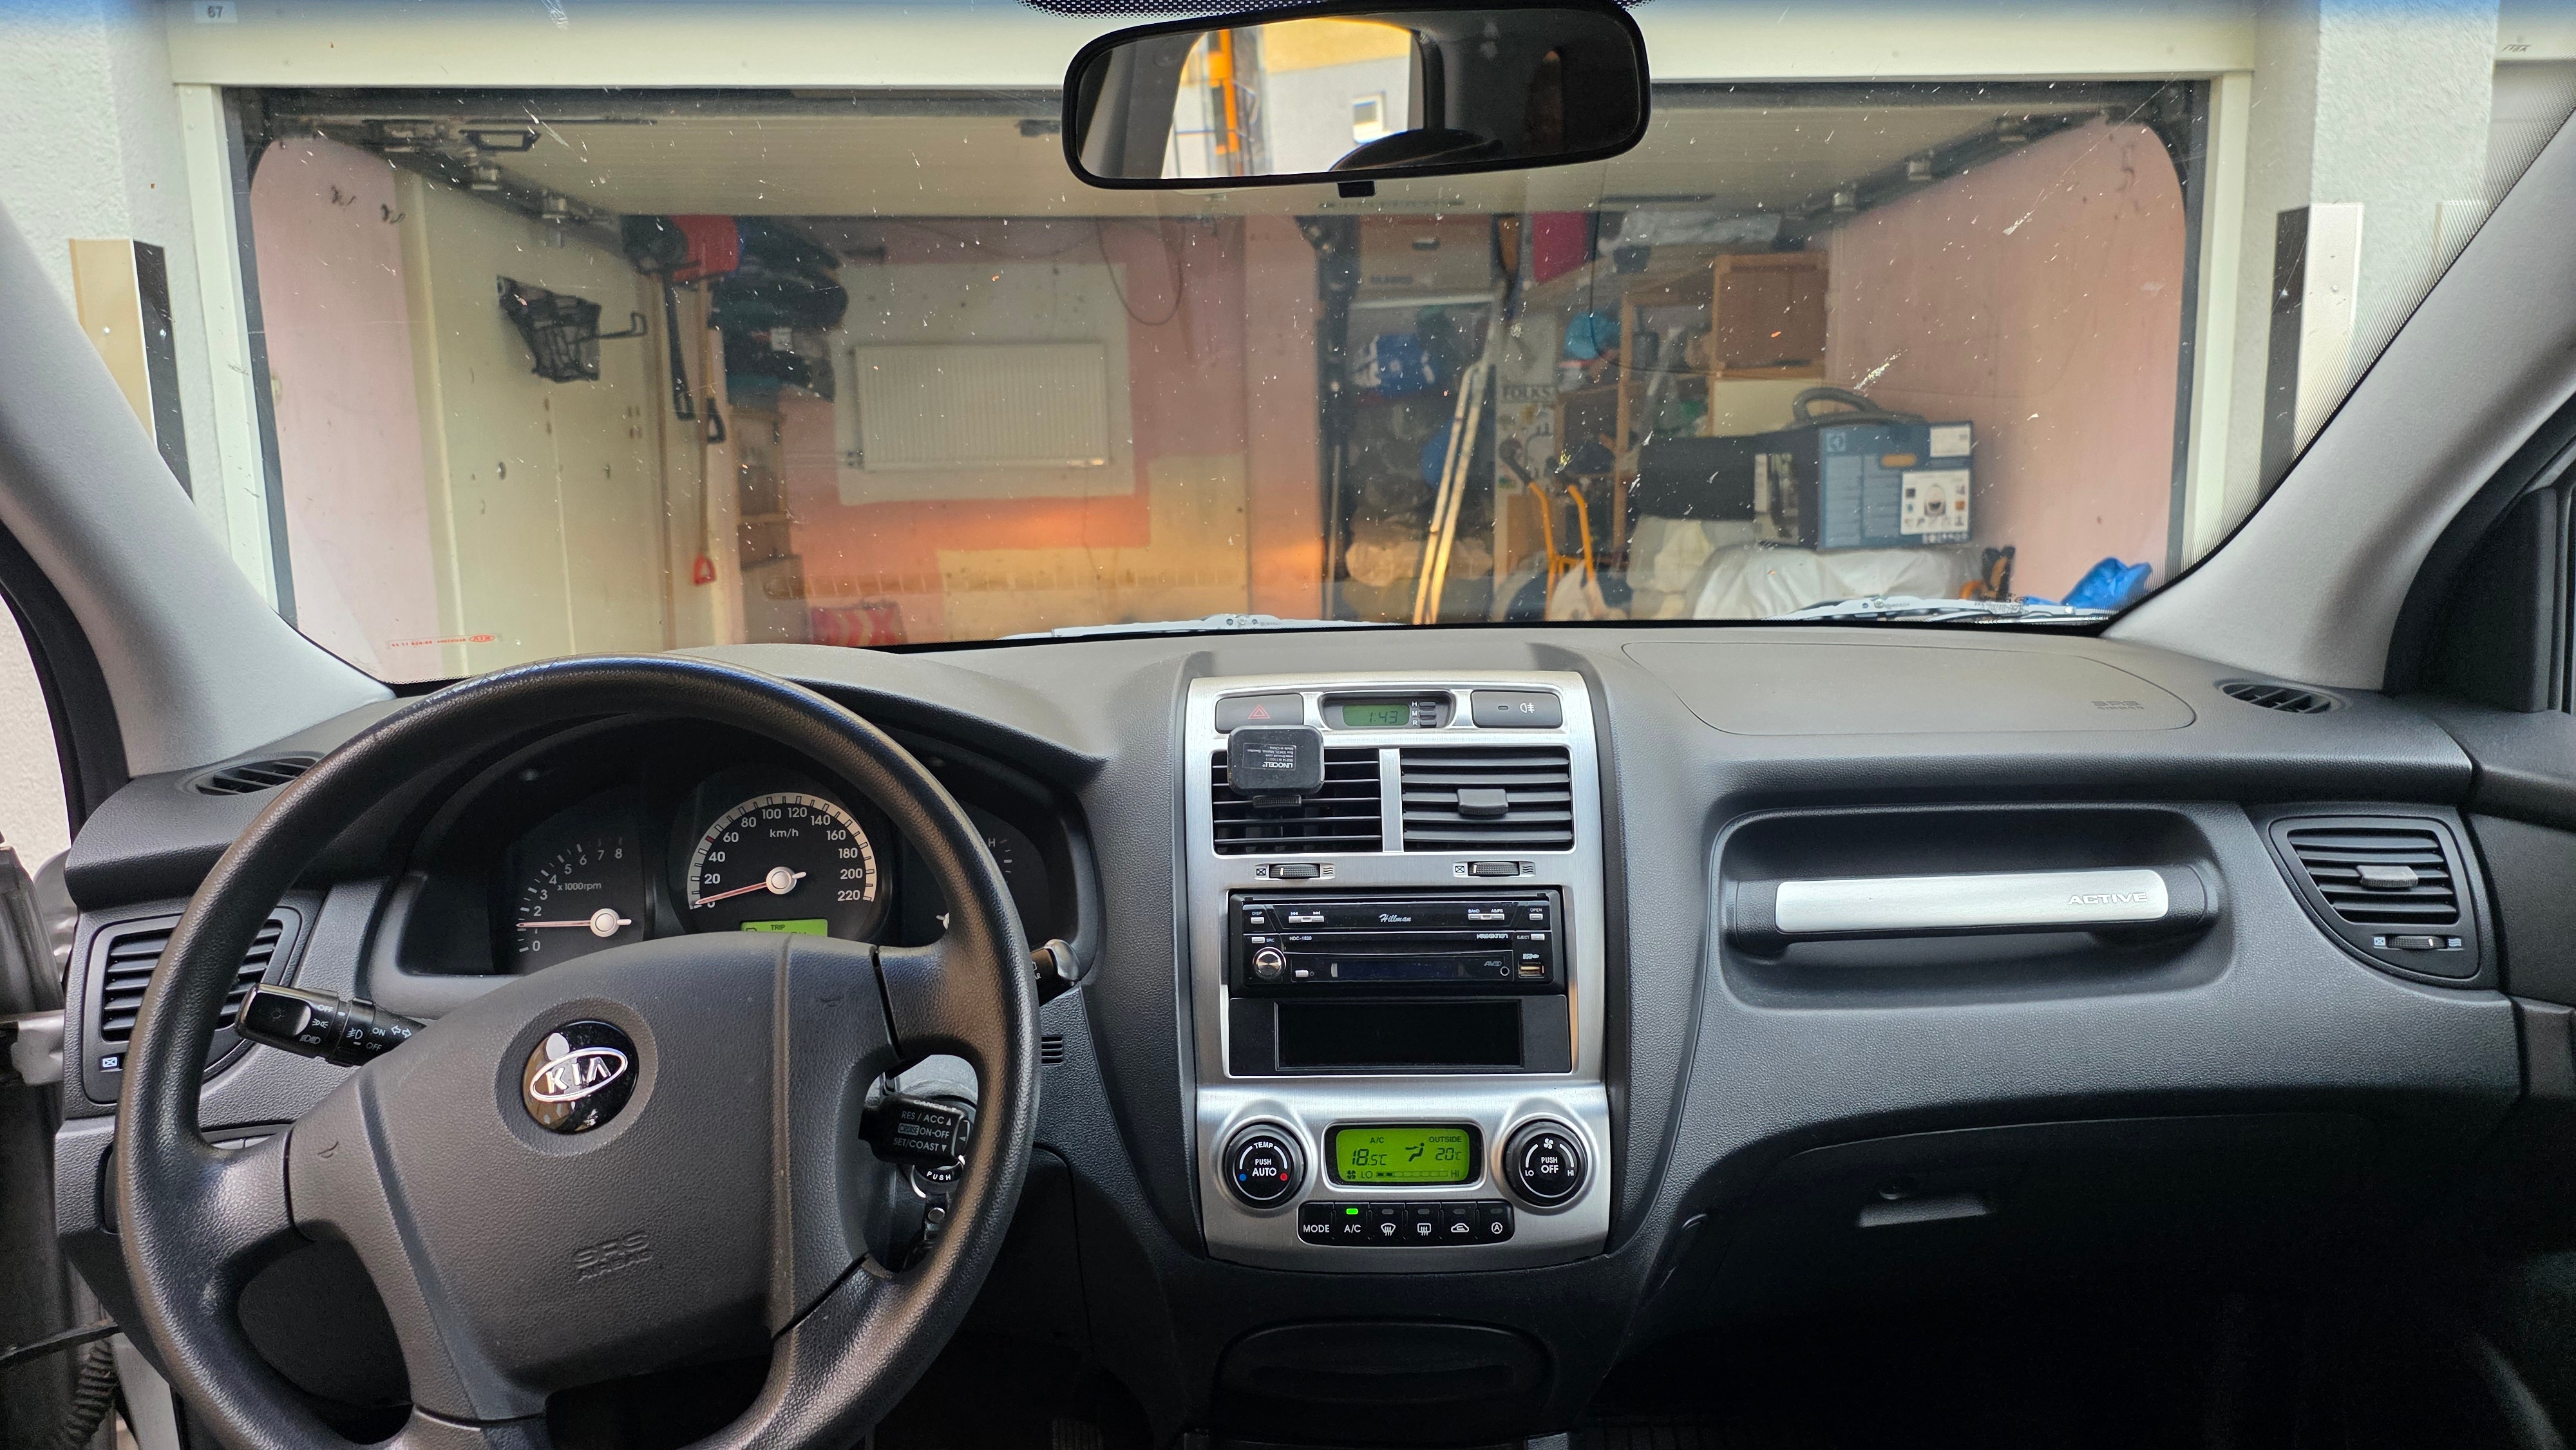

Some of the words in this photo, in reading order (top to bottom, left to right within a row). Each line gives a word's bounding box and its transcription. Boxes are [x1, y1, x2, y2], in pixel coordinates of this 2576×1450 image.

[207, 5, 223, 19] 67
[1369, 710, 1399, 724] 1:43
[761, 808, 781, 820] 100
[788, 807, 808, 818] 120
[741, 816, 757, 828] 80
[810, 814, 831, 825] 140
[723, 831, 739, 843] 60
[770, 828, 799, 838] km/h
[826, 829, 846, 840] 160
[988, 838, 996, 847] H
[597, 849, 605, 861] 7
[614, 848, 623, 859] 8
[708, 851, 726, 862] 40
[838, 847, 858, 859] 180
[579, 854, 587, 865] 6
[564, 863, 572, 874] 5
[840, 868, 863, 880] 200
[549, 874, 557, 885] 4
[704, 873, 721, 884] 20
[540, 889, 548, 900] 3
[837, 889, 860, 901] 220
[2067, 892, 2148, 905] ACTIVE
[533, 905, 542, 917] 2
[1379, 913, 1412, 923] Hillman
[532, 940, 541, 952] 0
[317, 1004, 334, 1013] OFF
[372, 1027, 386, 1037] ON
[366, 1042, 383, 1051] OFF
[545, 1056, 612, 1094] KIA
[902, 1111, 916, 1120] RES
[923, 1114, 945, 1124] ACC
[920, 1127, 950, 1139] ON-OFF
[893, 1137, 940, 1152] SET/COAST
[1253, 1141, 1274, 1149] TEMP
[1252, 1167, 1277, 1177] AUTO
[1450, 1169, 1460, 1178] HI
[1540, 1164, 1559, 1174] OFF
[926, 1171, 951, 1181] PUSH
[1361, 1171, 1373, 1180] LO
[1303, 1224, 1330, 1233] MODE
[1343, 1224, 1361, 1233] A/C
